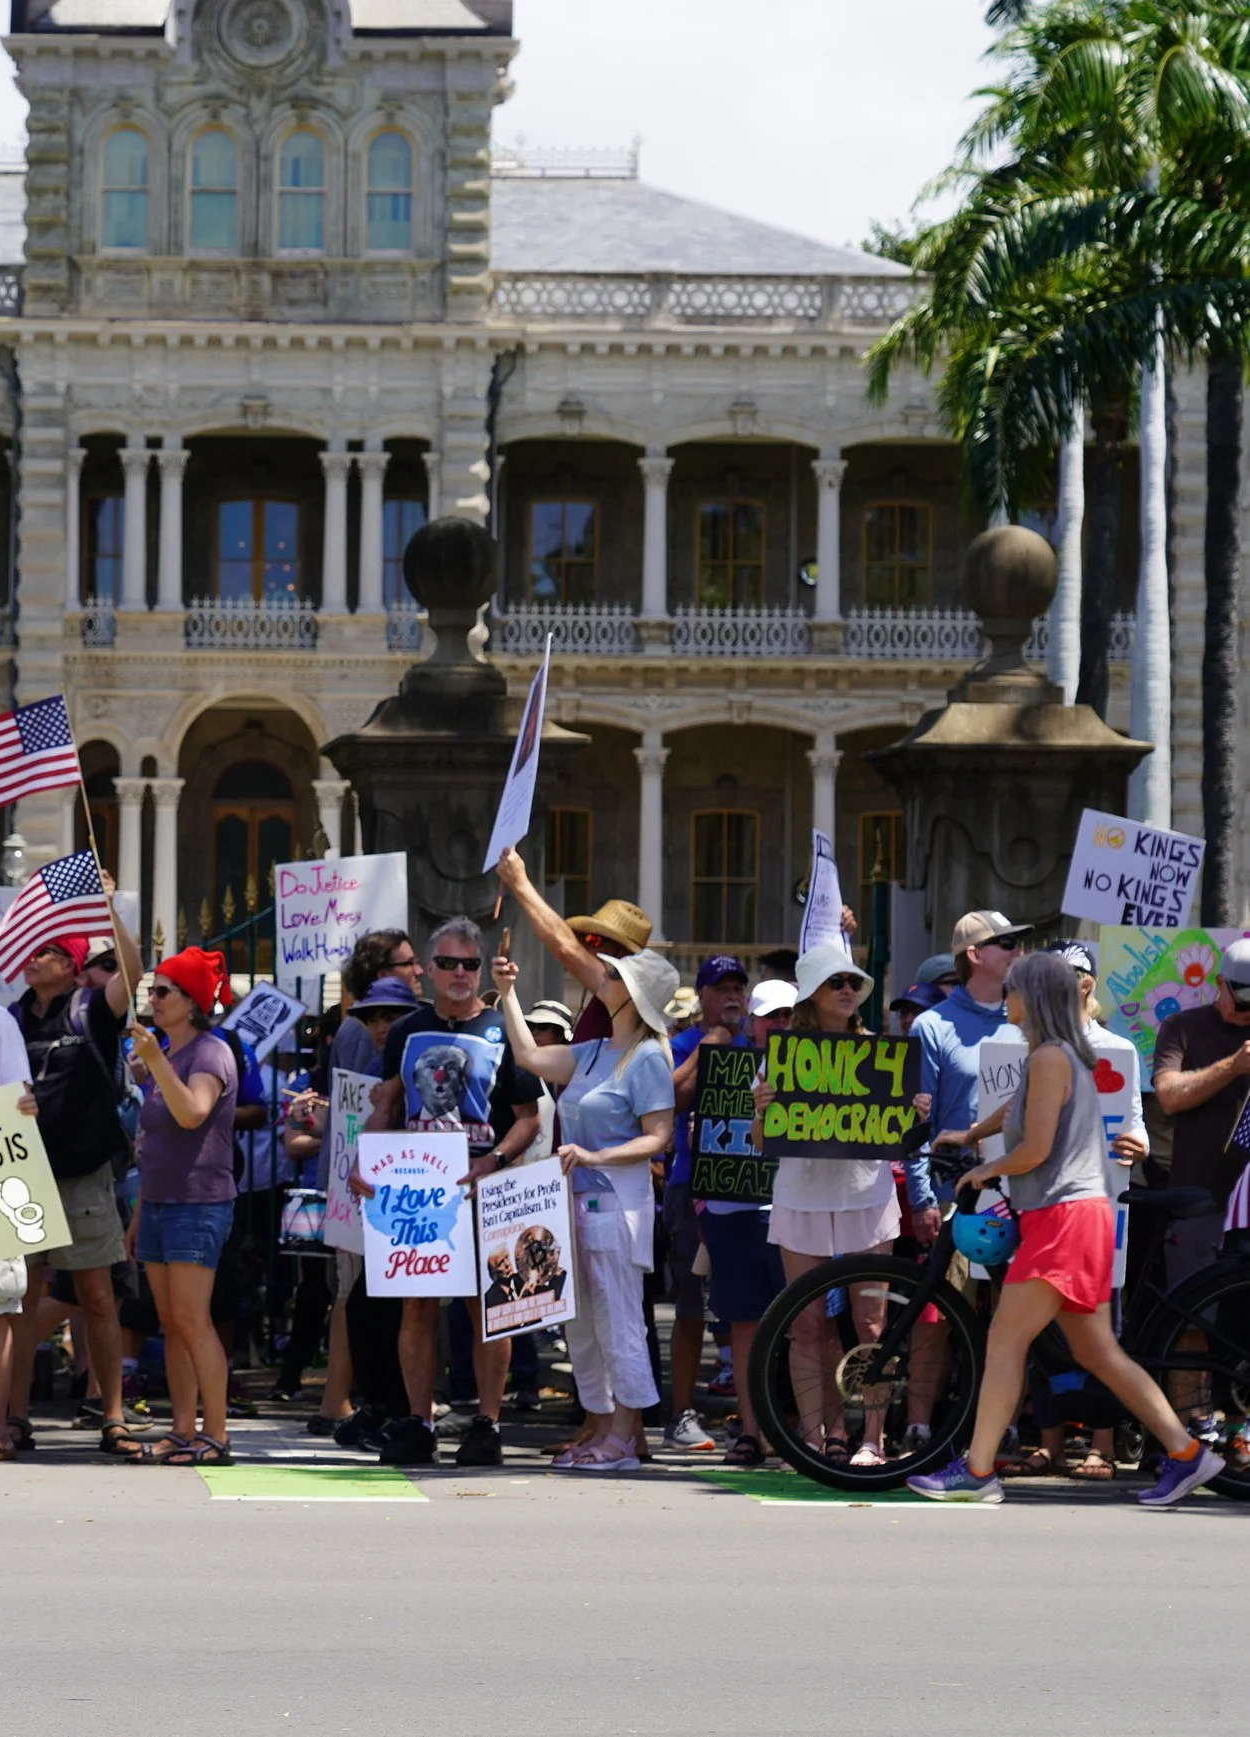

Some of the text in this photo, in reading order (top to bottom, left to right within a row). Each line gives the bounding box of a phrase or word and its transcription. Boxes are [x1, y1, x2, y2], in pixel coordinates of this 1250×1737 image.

[1134, 830, 1202, 868] KINGS
[280, 865, 359, 898] Do Justice
[1084, 868, 1187, 913] NO KINGS
[1150, 862, 1191, 888] NOW
[281, 903, 322, 929] Love
[766, 1034, 908, 1097] HONK 4
[980, 1057, 1024, 1095] HON
[337, 1073, 366, 1113] TAKE
[763, 1101, 916, 1146] DEMOCRACY
[5, 1133, 28, 1163] IS
[371, 1148, 450, 1176] MAD AS HELL
[481, 1178, 517, 1199] Using the
[524, 1186, 536, 1201] for
[537, 1179, 561, 1197] Profit
[692, 1158, 780, 1197] AGAI
[380, 1183, 446, 1215] I Love
[391, 1216, 438, 1247] This
[385, 1248, 451, 1279] Place
